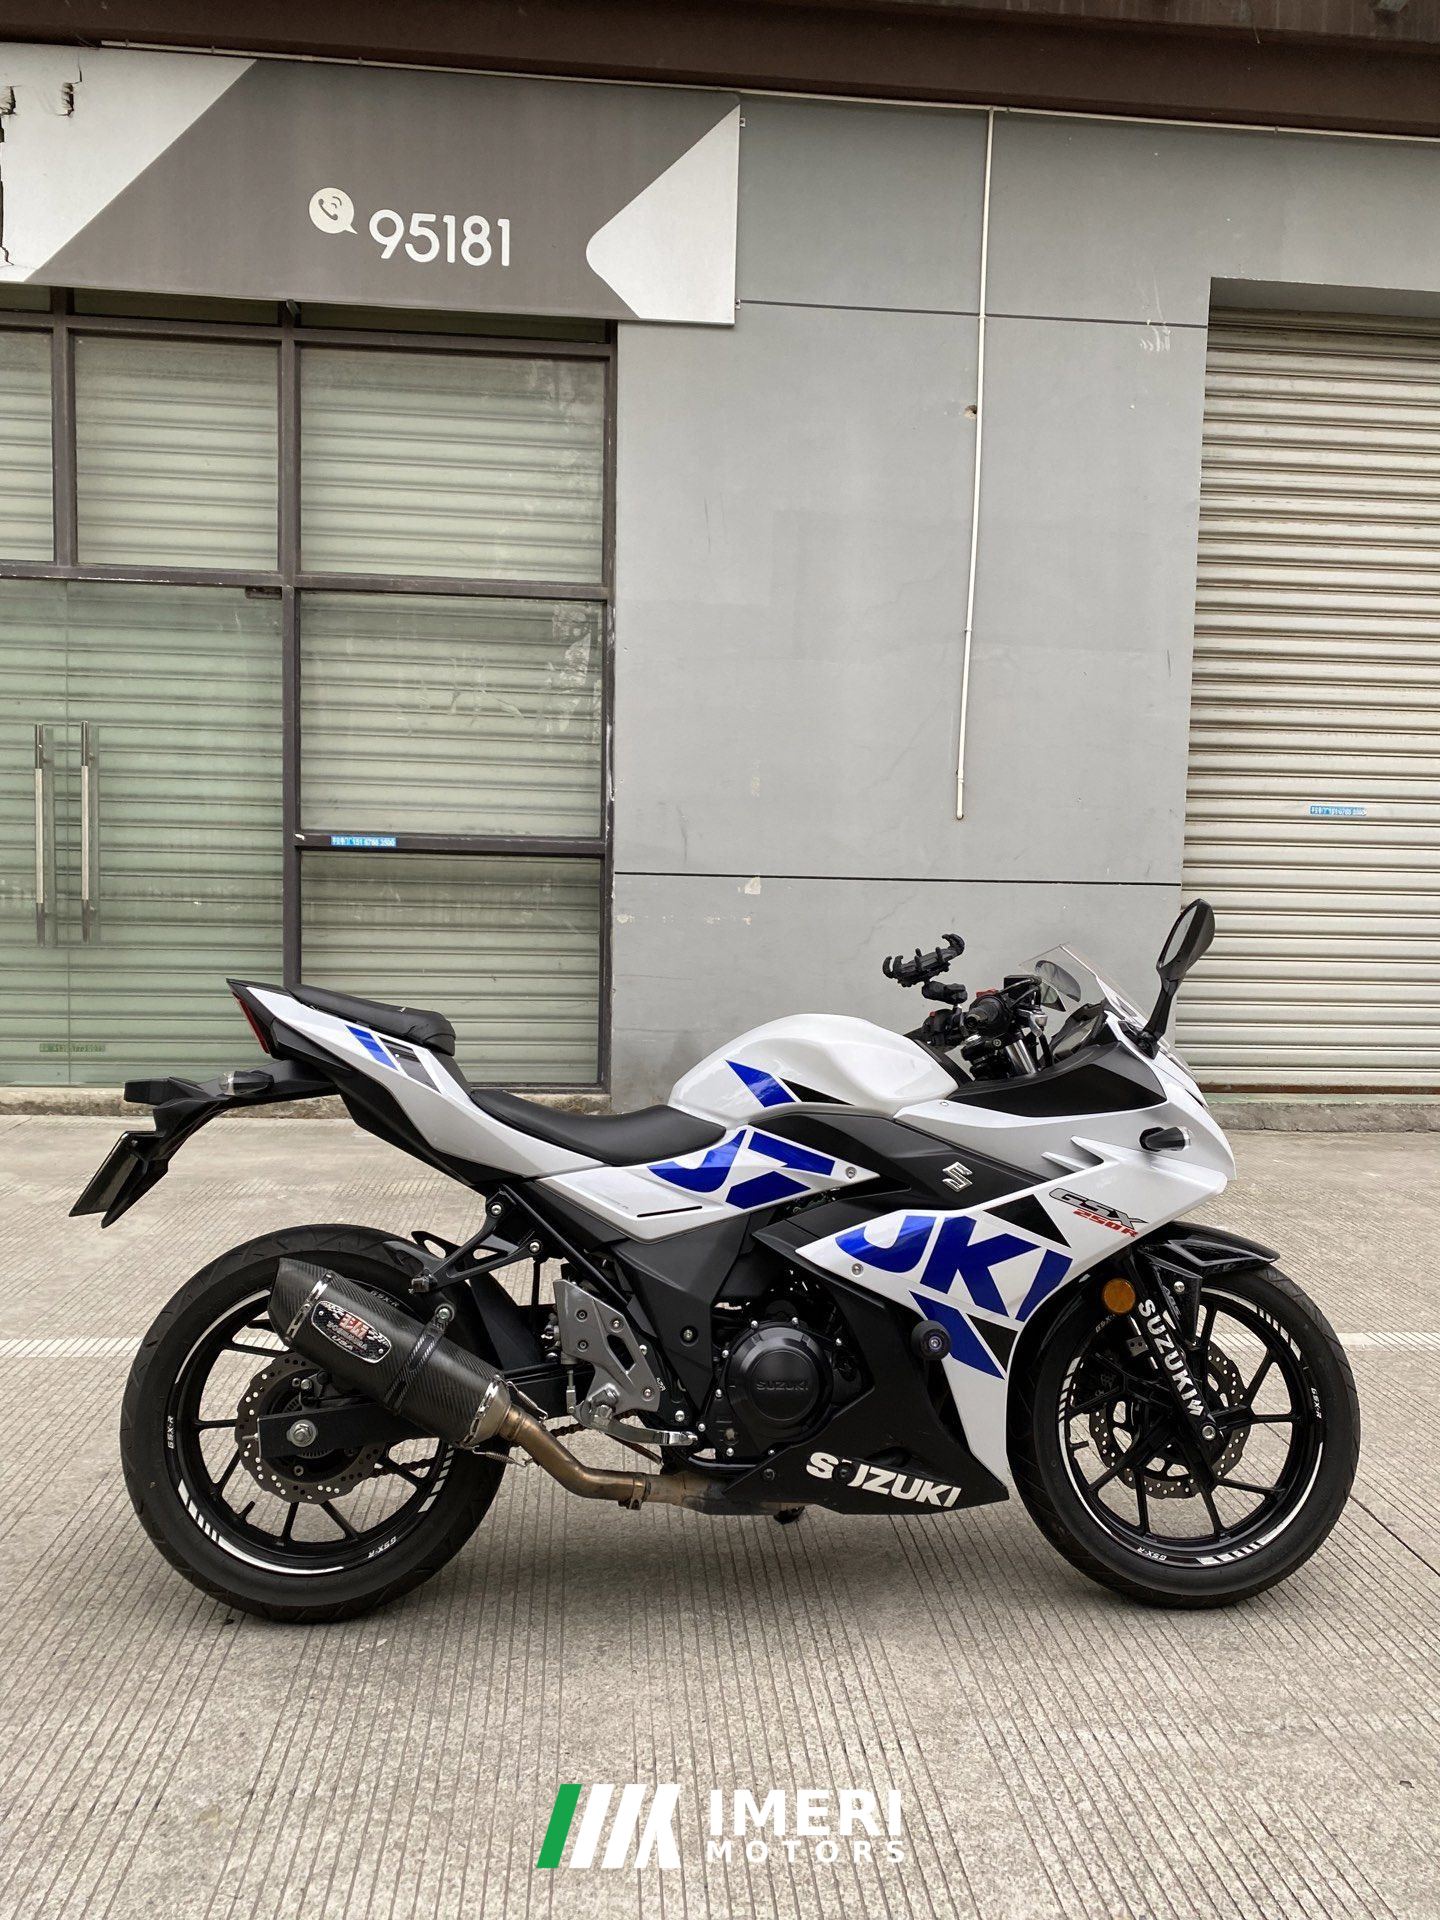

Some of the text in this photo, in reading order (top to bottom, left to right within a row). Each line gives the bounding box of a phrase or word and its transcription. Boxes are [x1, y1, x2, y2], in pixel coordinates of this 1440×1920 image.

[368, 208, 511, 267] 95181
[1048, 1187, 1149, 1230] GSX
[1073, 1208, 1139, 1238] 250R
[1137, 1299, 1198, 1401] SUZUKI
[756, 1380, 809, 1391] SUZUKI
[1310, 1387, 1322, 1419] GSX-R
[167, 1415, 175, 1449] GSX-R
[1137, 1547, 1168, 1561] GSX-R
